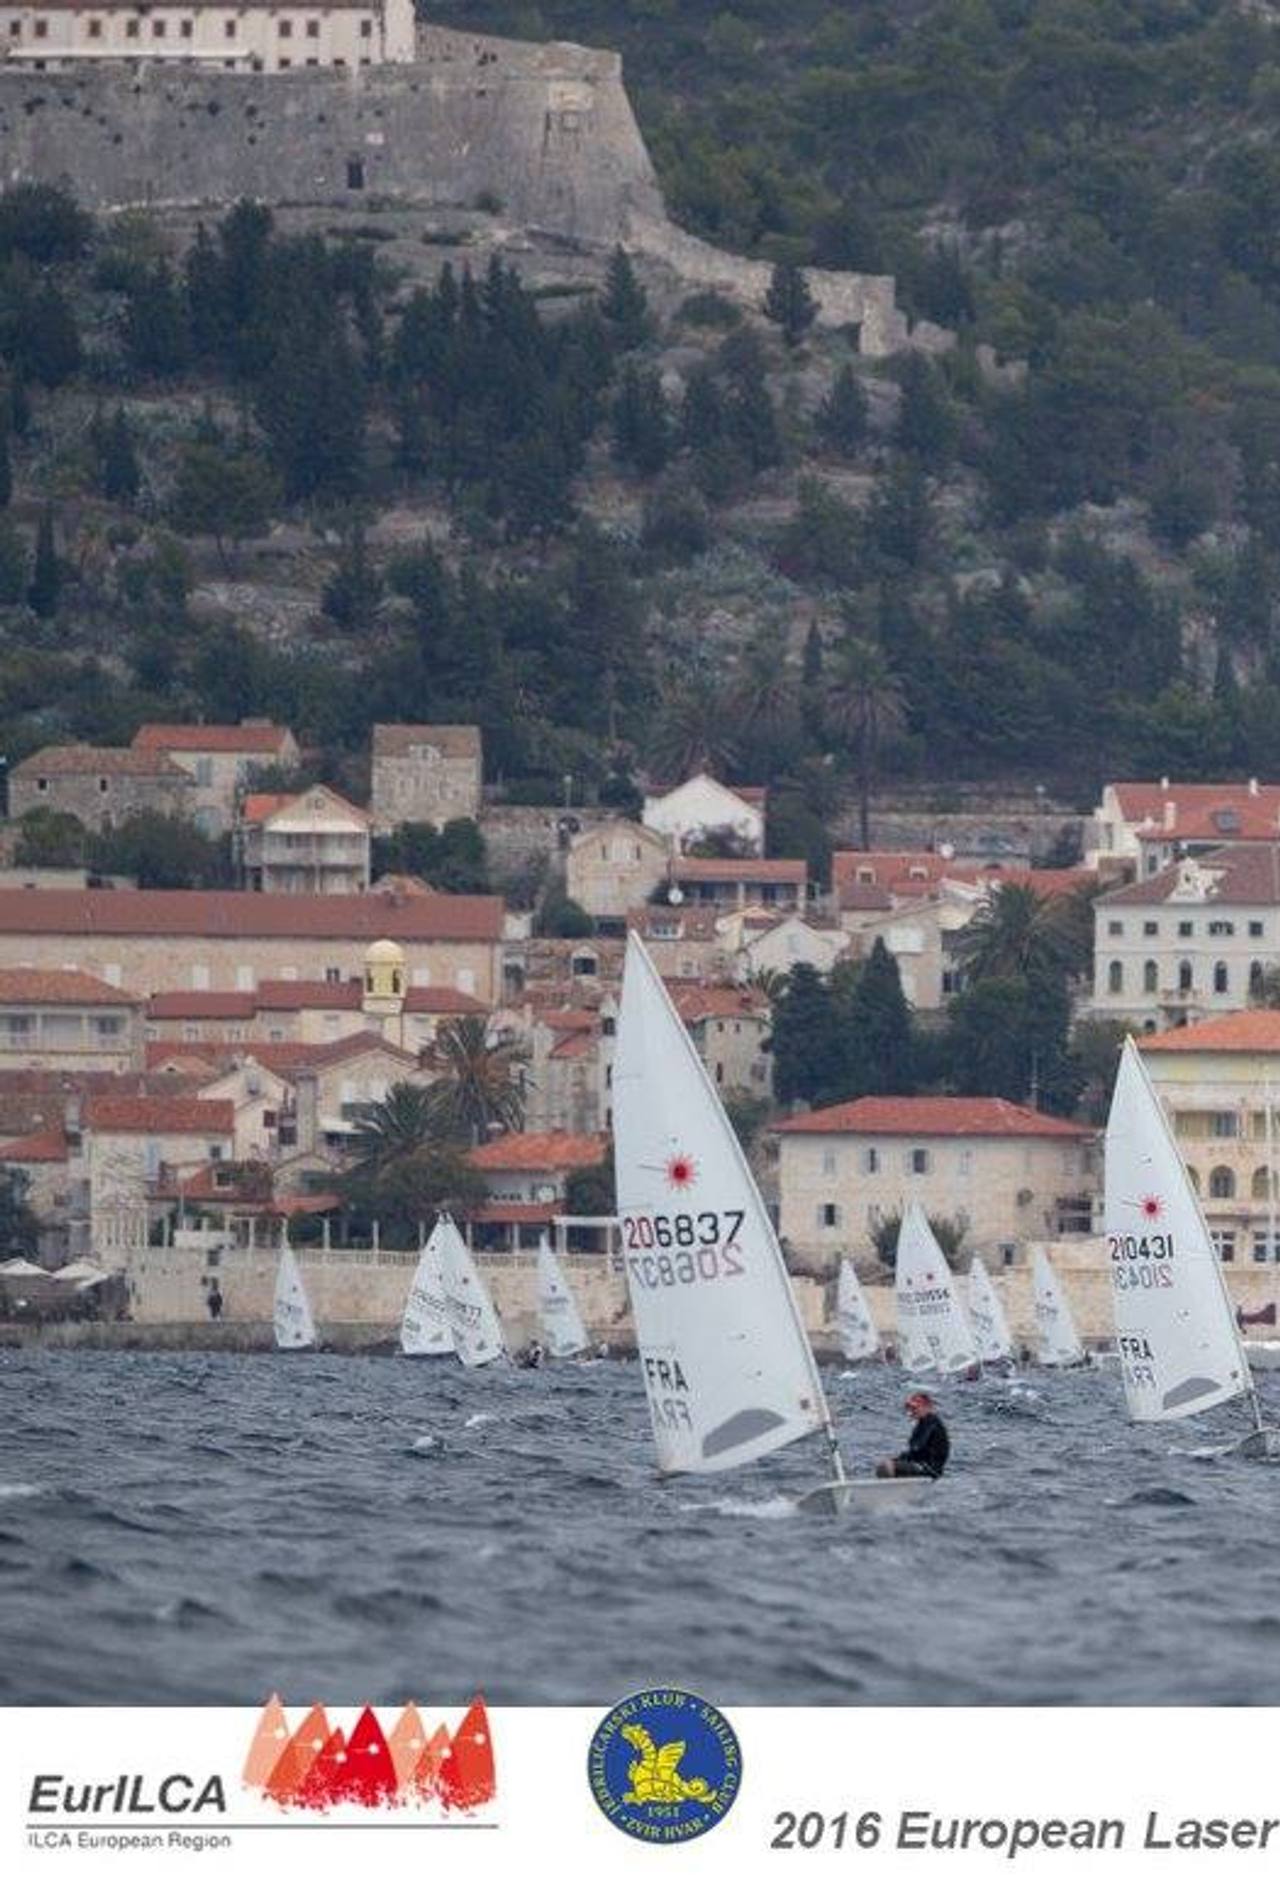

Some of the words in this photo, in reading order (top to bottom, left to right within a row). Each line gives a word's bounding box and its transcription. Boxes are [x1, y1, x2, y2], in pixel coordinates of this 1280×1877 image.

[623, 1210, 745, 1249] 206837
[1109, 1233, 1174, 1260] 210431
[1121, 1338, 1155, 1360] FRA
[645, 1358, 689, 1393] FRA
